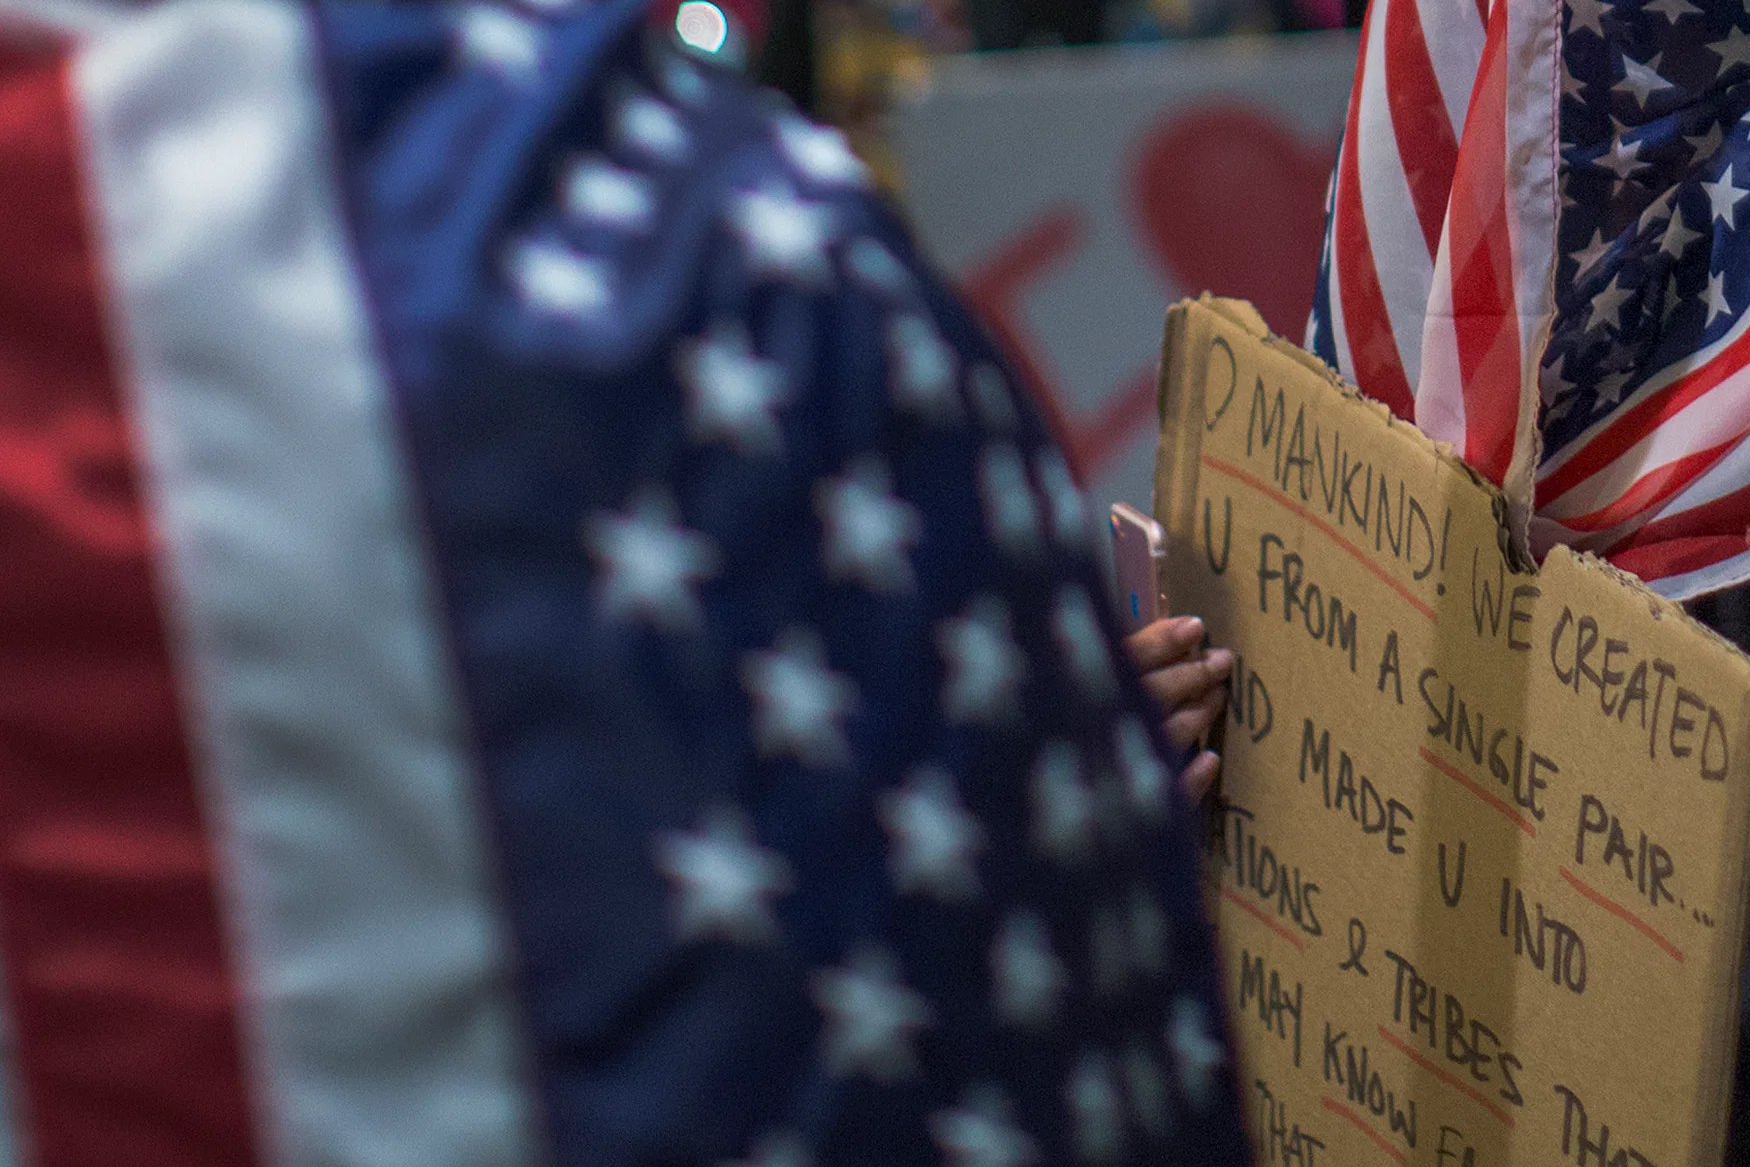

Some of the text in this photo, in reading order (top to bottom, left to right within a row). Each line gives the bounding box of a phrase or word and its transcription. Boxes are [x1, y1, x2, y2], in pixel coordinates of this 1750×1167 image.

[1204, 496, 1232, 575] U
[1256, 533, 1358, 673] FROM
[1377, 629, 1404, 705] A
[1418, 667, 1560, 822] SINGLE
[1246, 374, 1452, 597] MANKIND!
[1471, 546, 1541, 651] WE
[1551, 604, 1729, 782] CREATED
[1228, 652, 1588, 995] ND MADE U INTO
[1239, 948, 1302, 1070] MAY
[1323, 1020, 1416, 1149] KNOW
[1384, 949, 1524, 1108] TRIBES
[1553, 1084, 1658, 1167] TH
